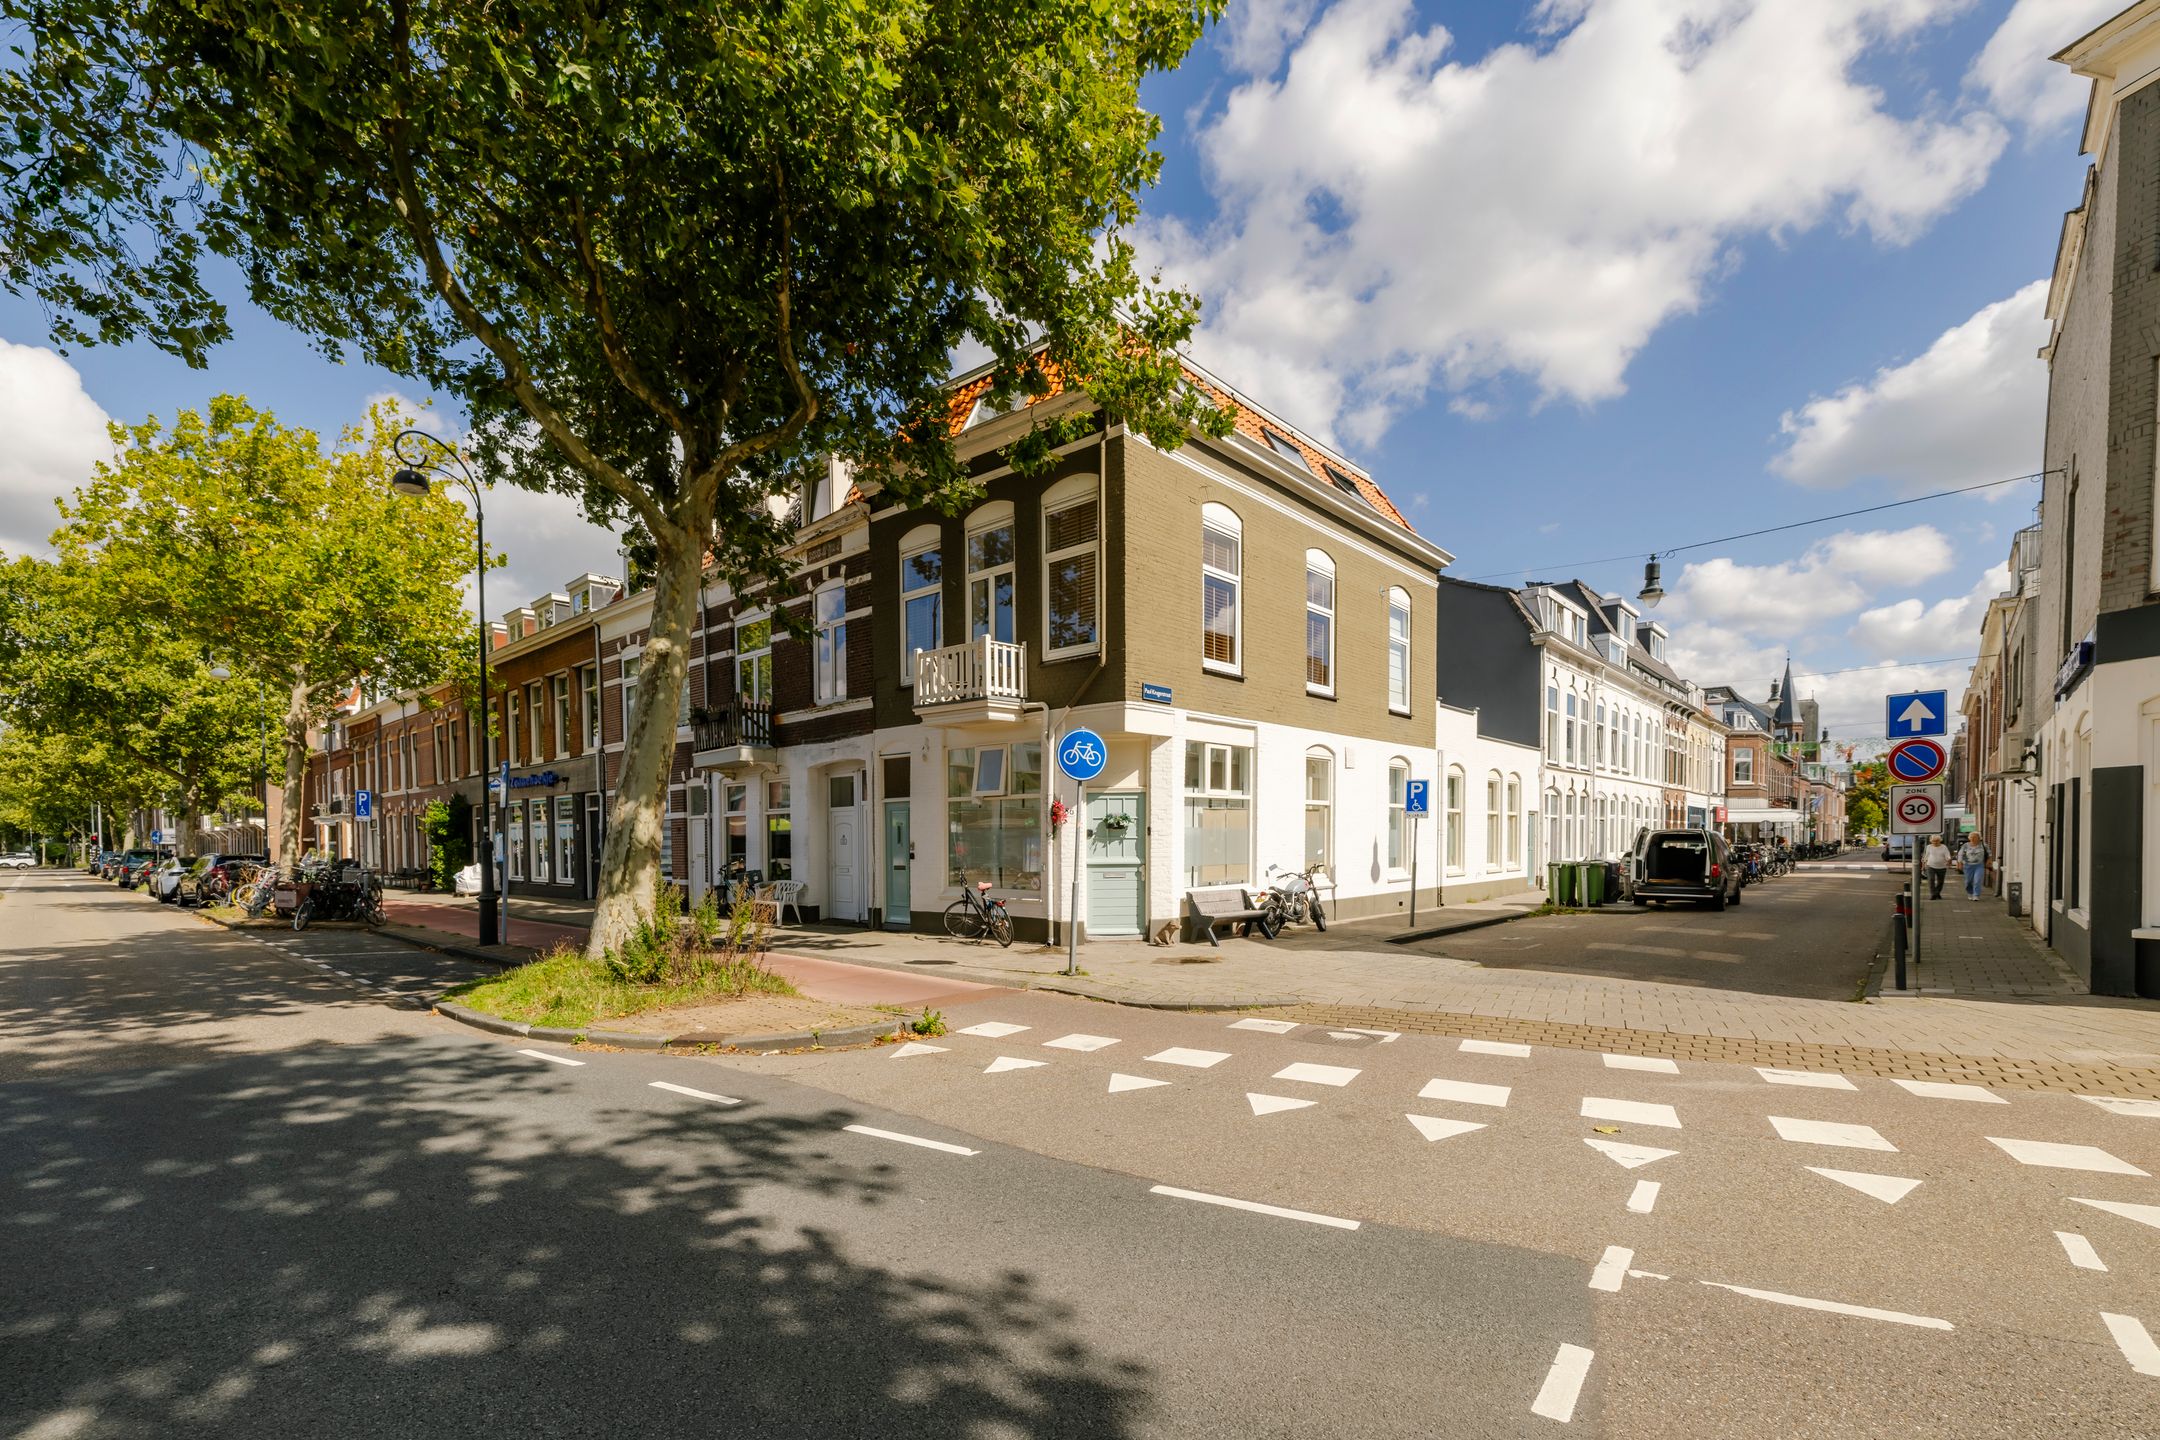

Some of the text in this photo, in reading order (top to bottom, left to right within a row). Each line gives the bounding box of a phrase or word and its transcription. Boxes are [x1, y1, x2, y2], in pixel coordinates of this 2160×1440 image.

[1410, 782, 1424, 799] P
[358, 792, 368, 806] P
[1904, 803, 1929, 816] 30
